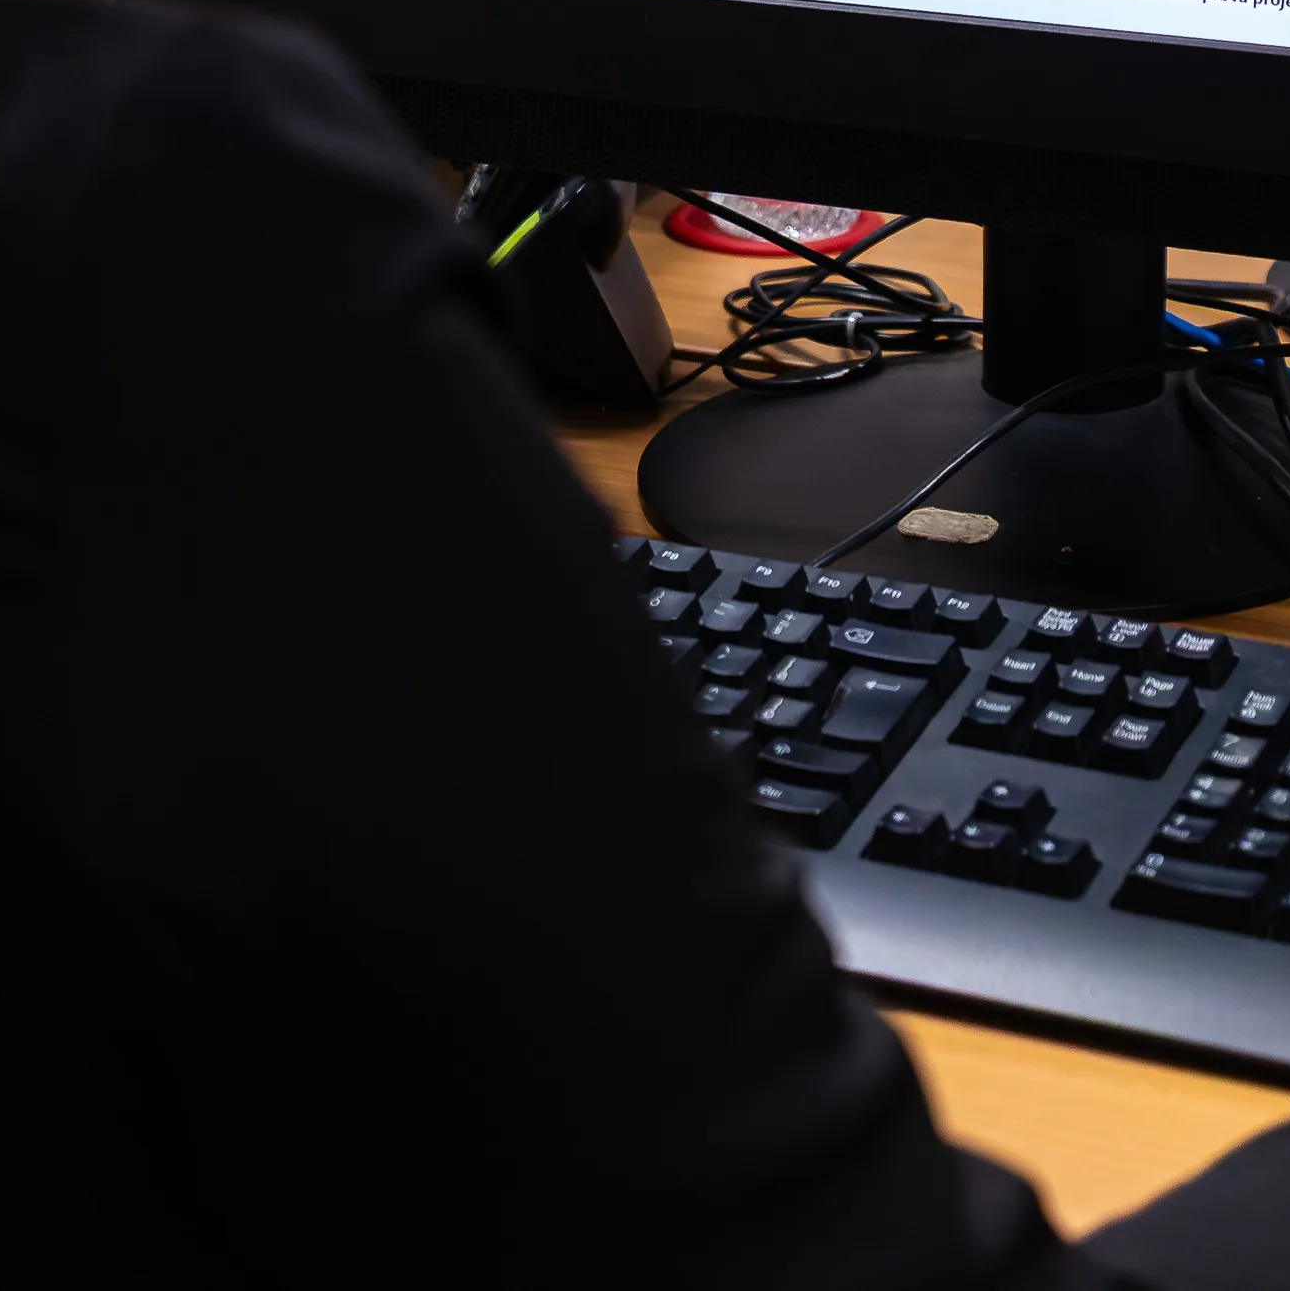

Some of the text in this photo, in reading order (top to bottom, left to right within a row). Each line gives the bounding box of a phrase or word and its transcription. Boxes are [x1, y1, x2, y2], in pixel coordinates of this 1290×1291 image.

[817, 575, 841, 588] F10
[882, 586, 902, 599] F11
[1071, 668, 1105, 683] Home
